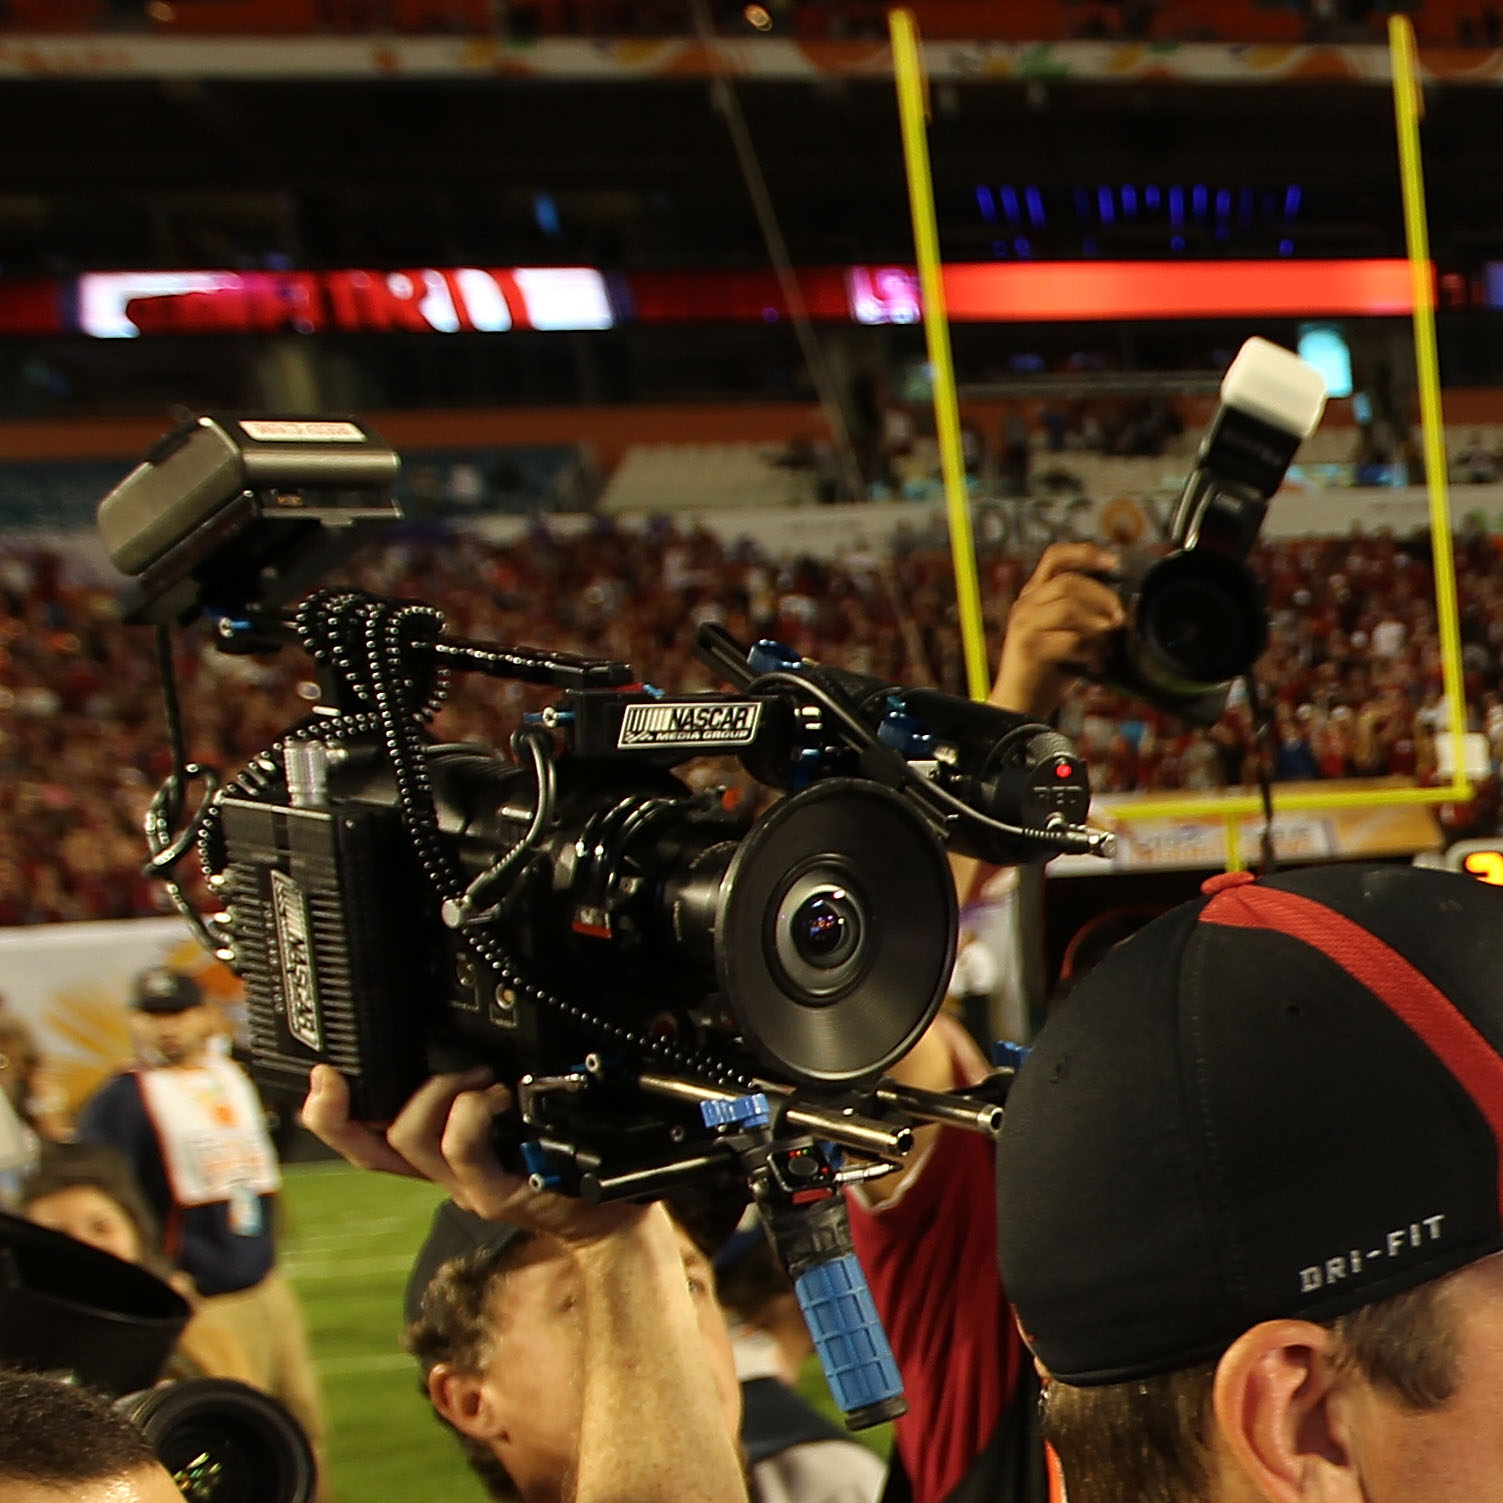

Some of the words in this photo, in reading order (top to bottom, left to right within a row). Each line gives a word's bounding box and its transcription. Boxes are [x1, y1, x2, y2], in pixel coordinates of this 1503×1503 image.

[667, 706, 750, 729] NASCAR
[656, 730, 701, 741] MEDIA
[702, 729, 750, 740] GROUP
[1299, 1214, 1446, 1293] DRI-FIT
